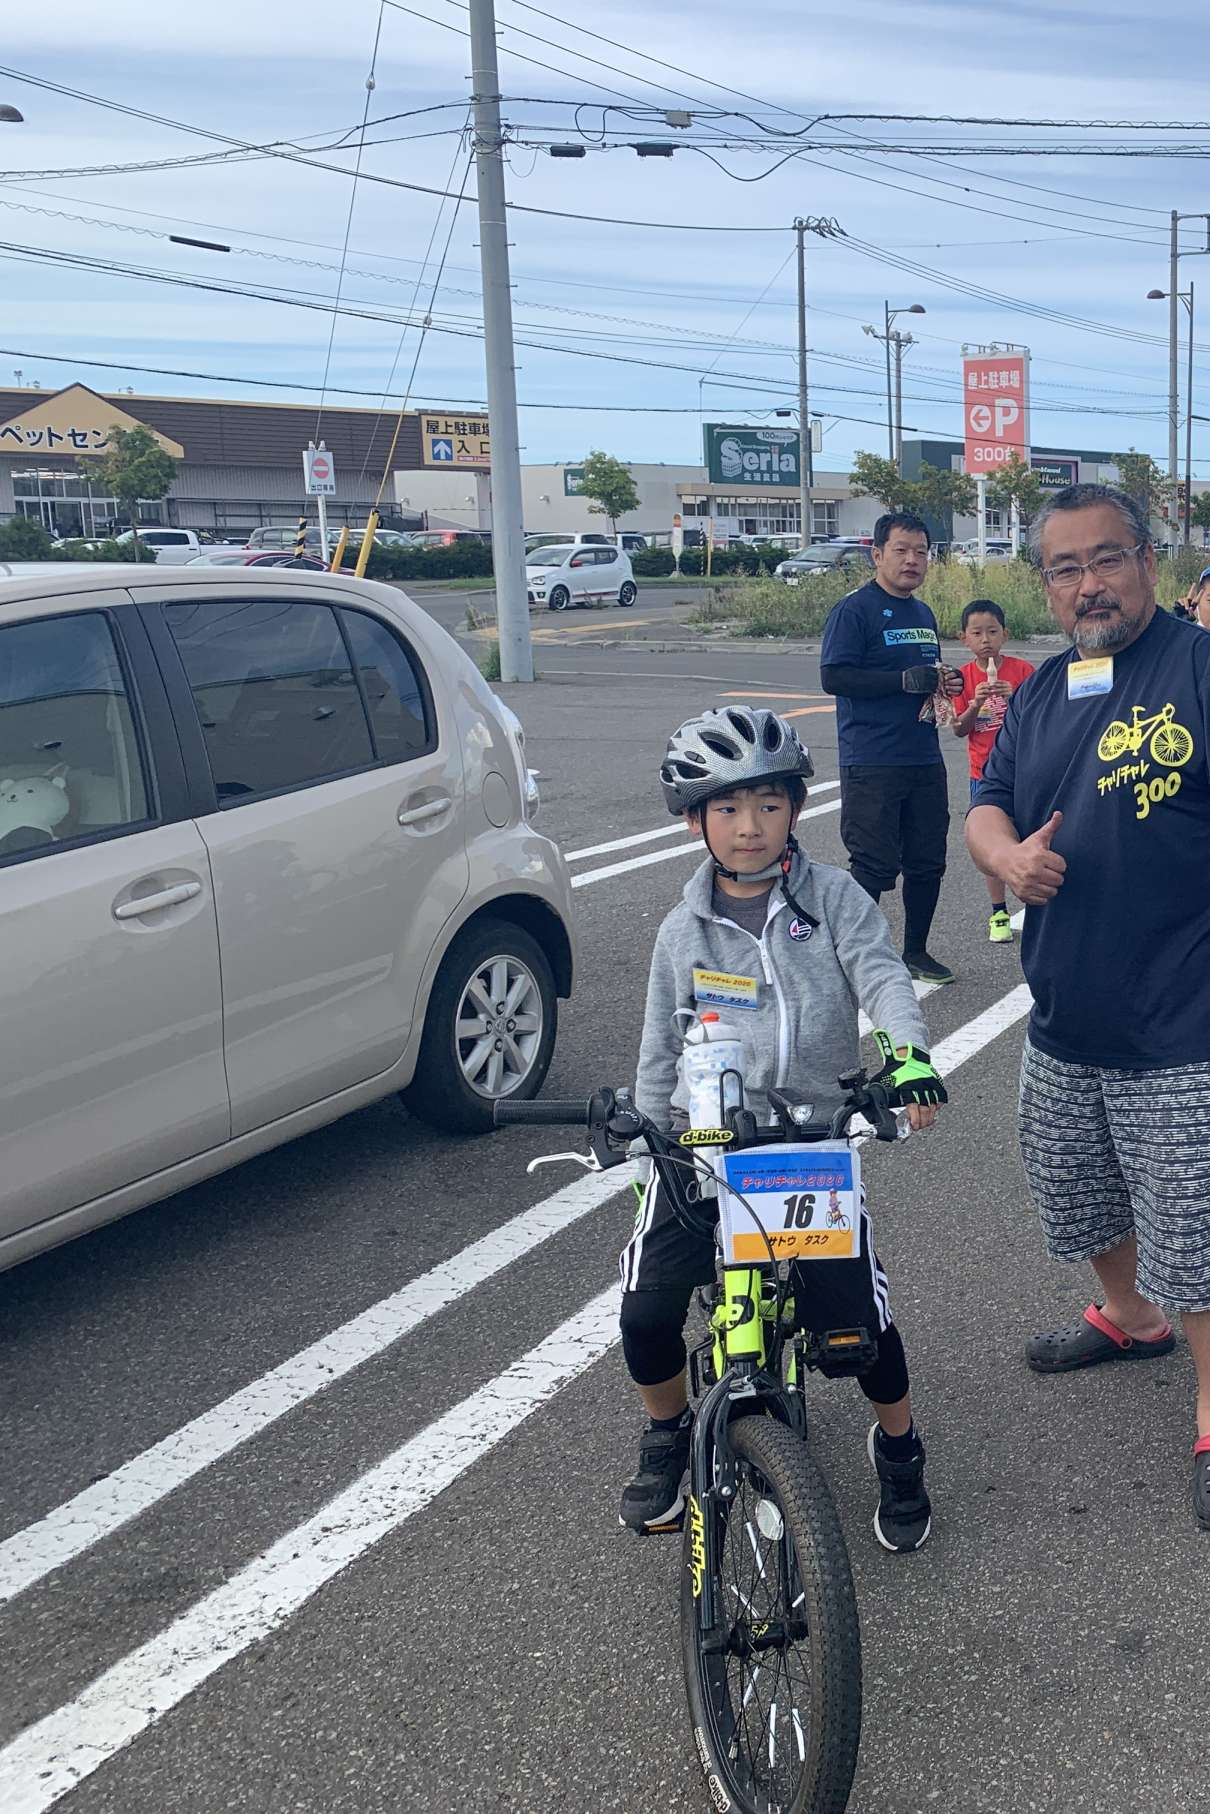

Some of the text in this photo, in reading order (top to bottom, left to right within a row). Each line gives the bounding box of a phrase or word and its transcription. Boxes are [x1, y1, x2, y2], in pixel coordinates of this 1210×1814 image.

[995, 398, 1019, 437] P
[721, 437, 797, 477] Seria
[887, 630, 917, 643] Sports
[1133, 771, 1182, 820] 300
[682, 1129, 732, 1143] d-bike
[783, 1193, 817, 1230] 16
[768, 1234, 830, 1247] サトウ タスク
